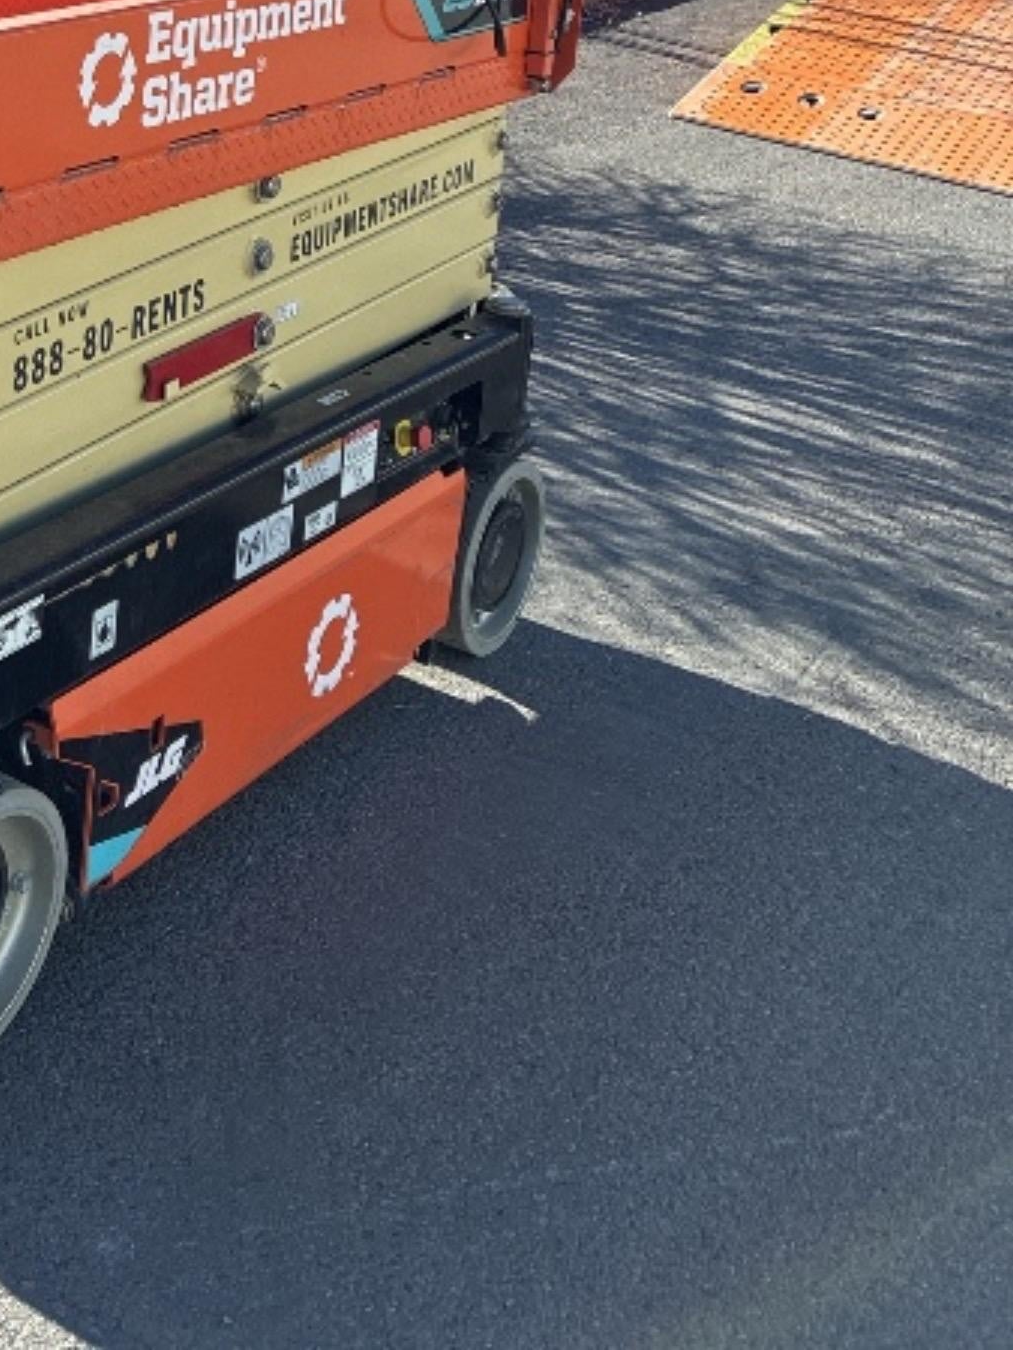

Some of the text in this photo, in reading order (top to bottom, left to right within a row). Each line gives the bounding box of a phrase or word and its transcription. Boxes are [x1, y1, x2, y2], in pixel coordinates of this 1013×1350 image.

[142, 67, 257, 128] Share
[13, 299, 90, 346] CALL NOW
[13, 277, 205, 392] 888-80-RENTS
[124, 734, 188, 808] JLG
